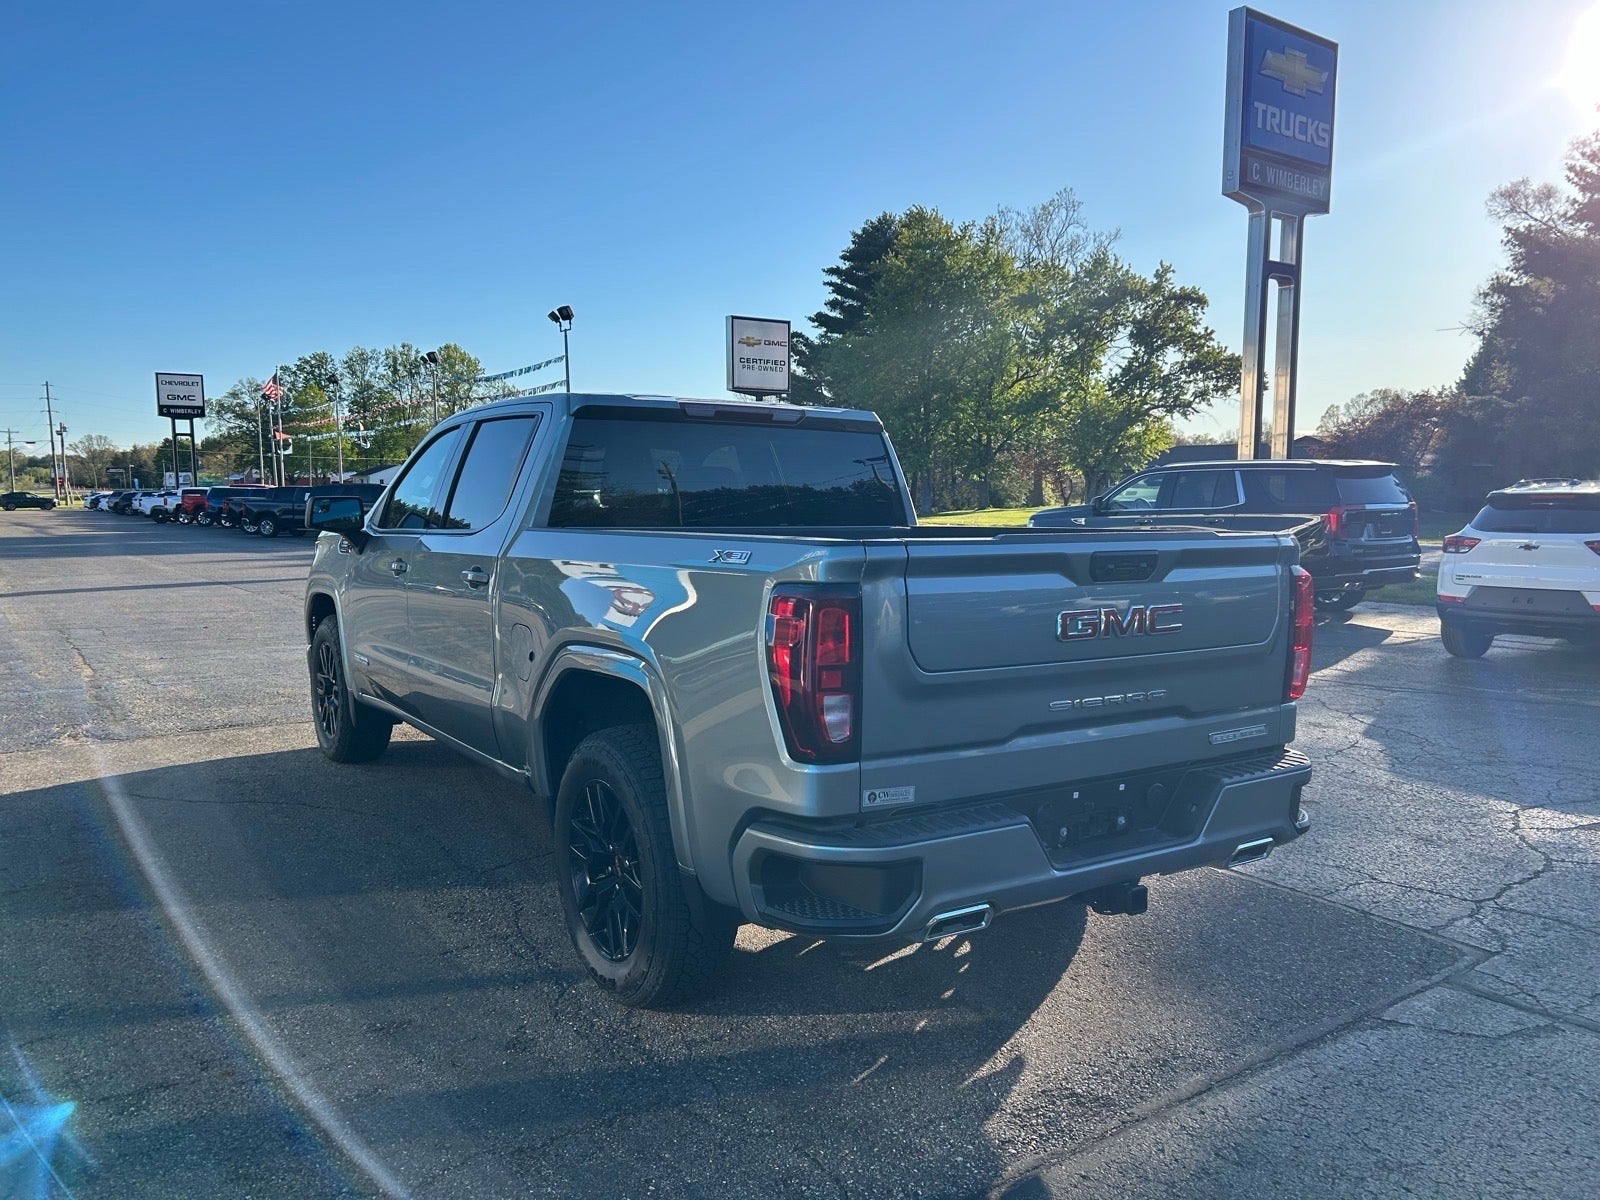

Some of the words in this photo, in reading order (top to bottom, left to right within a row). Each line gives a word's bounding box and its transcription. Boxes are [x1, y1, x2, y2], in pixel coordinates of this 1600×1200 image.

[1253, 100, 1330, 149] TRUCKS
[1266, 166, 1326, 198] WIMBERLEY
[763, 339, 788, 347] GMC
[739, 357, 786, 367] CERTIFIED
[741, 364, 784, 373] PRE-OWNED
[160, 379, 200, 387] CHEVROLET
[166, 393, 197, 402] GMC
[707, 549, 752, 565] X31
[1056, 603, 1184, 642] GMC
[1049, 689, 1168, 712] SIERRA
